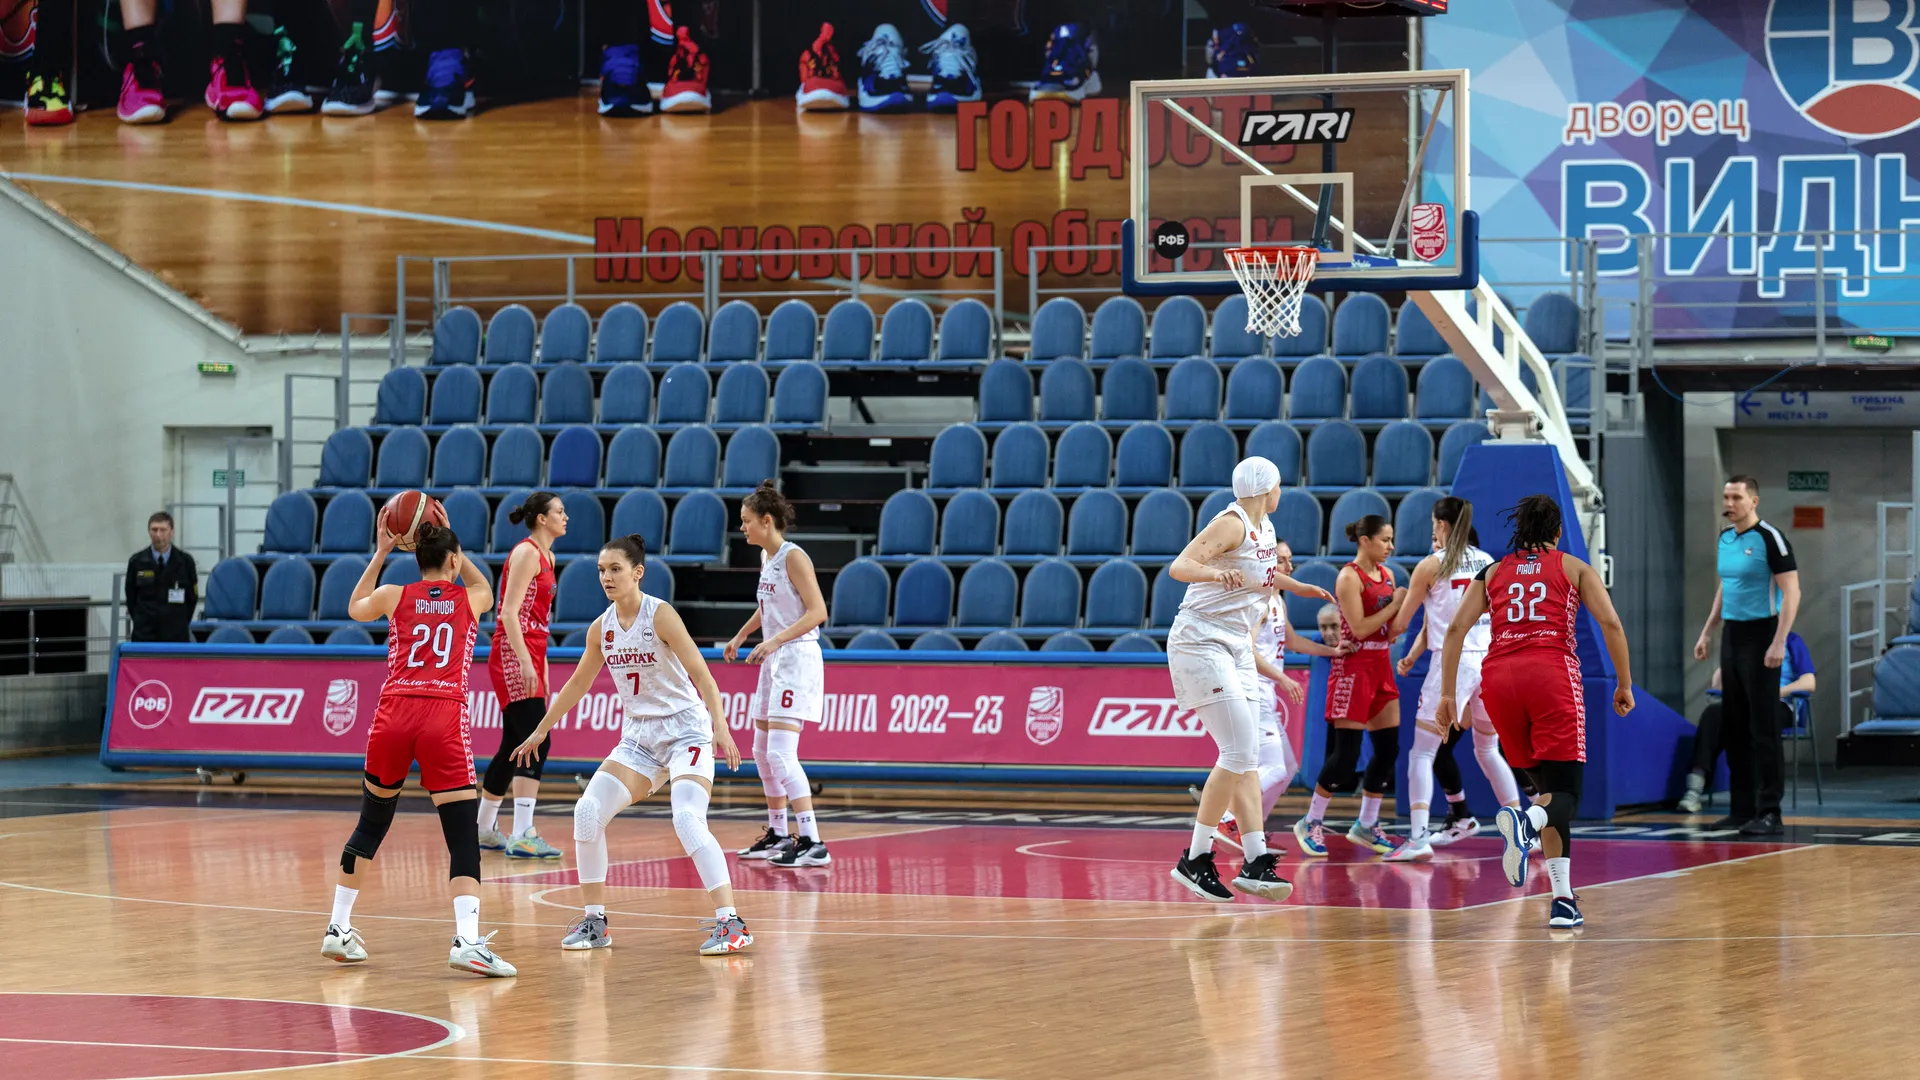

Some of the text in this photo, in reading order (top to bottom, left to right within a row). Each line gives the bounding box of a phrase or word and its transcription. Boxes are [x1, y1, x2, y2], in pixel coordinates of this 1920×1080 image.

[1242, 111, 1350, 143] PARI
[1565, 100, 1748, 144] дворец
[594, 207, 995, 283] Московской
[1158, 233, 1185, 247] РФБ
[1516, 560, 1542, 576] МАЙГА
[415, 599, 455, 616] КРЫМОВА
[1507, 581, 1548, 624] 32
[407, 622, 454, 669] 29
[626, 672, 641, 696] 7
[134, 696, 167, 712] РФБ
[195, 692, 301, 719] PARI
[781, 689, 794, 709] 6
[688, 745, 702, 767] 7
